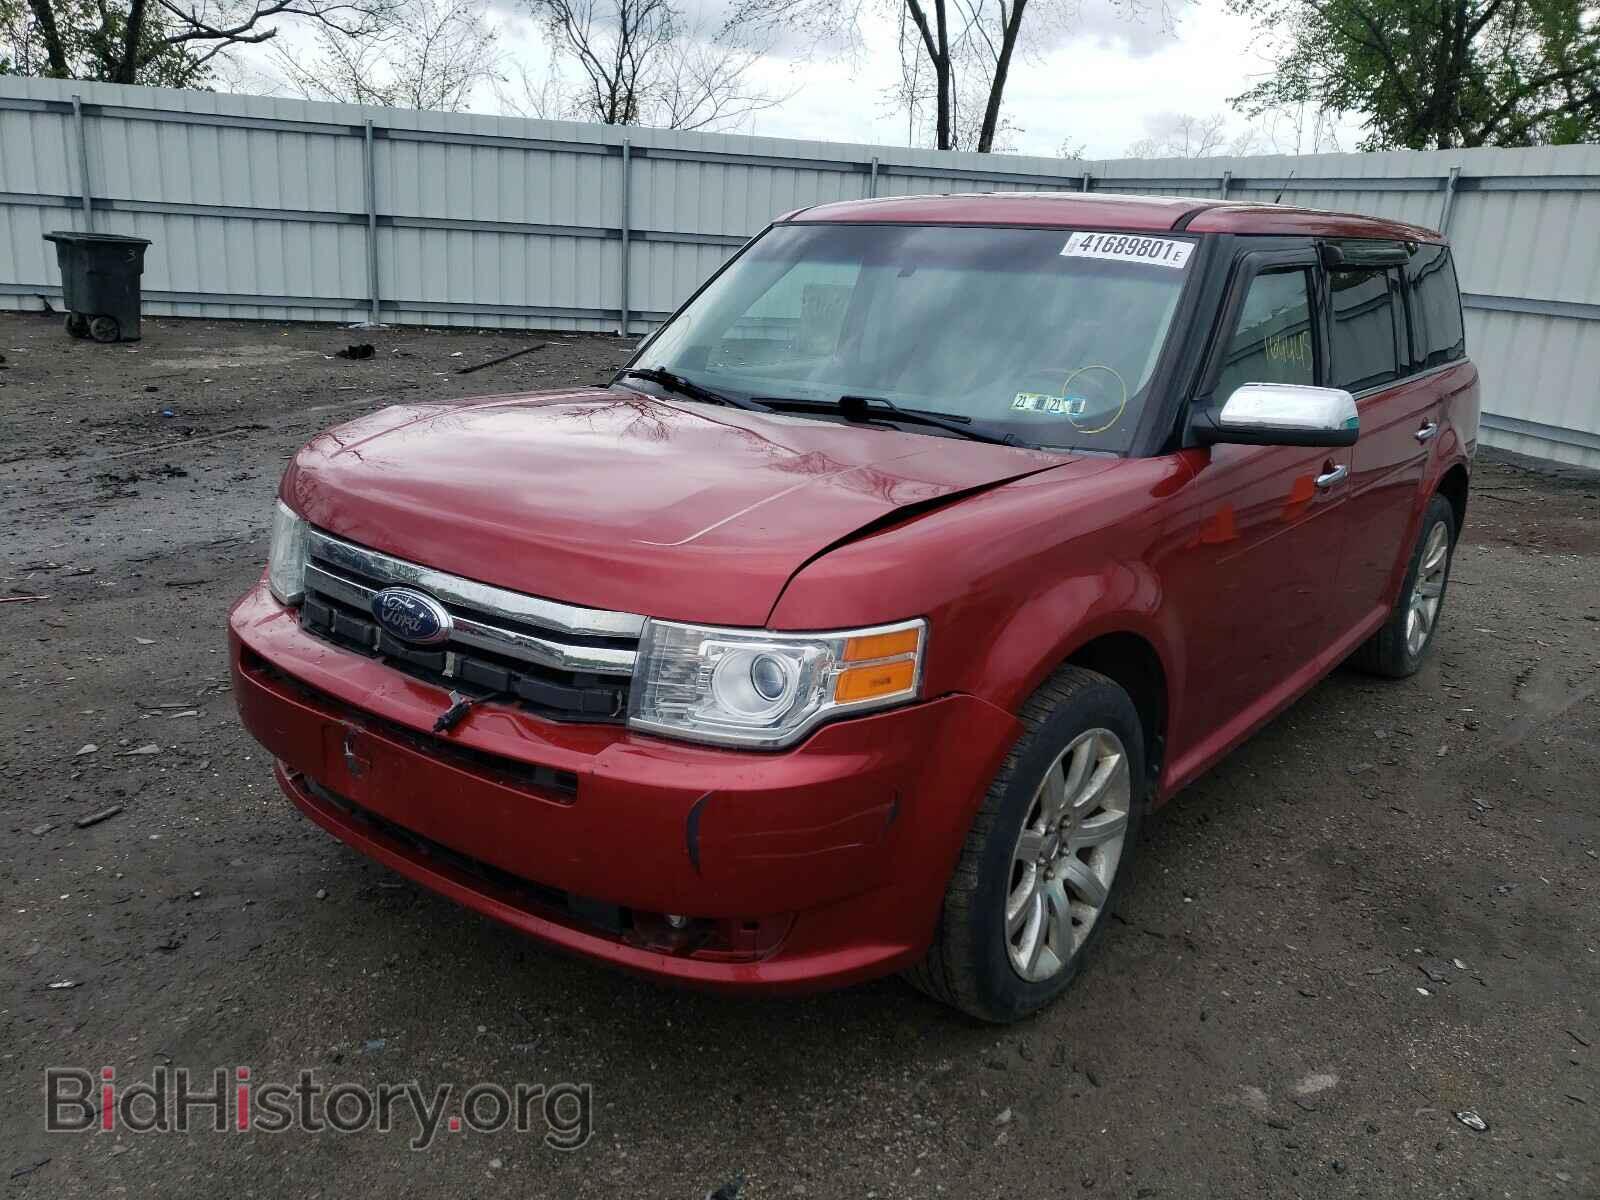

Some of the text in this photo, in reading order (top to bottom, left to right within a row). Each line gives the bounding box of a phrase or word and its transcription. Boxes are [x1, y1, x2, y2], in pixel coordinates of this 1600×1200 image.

[1080, 234, 1173, 260] 41689801
[1173, 251, 1184, 262] E
[381, 596, 426, 633] Ford
